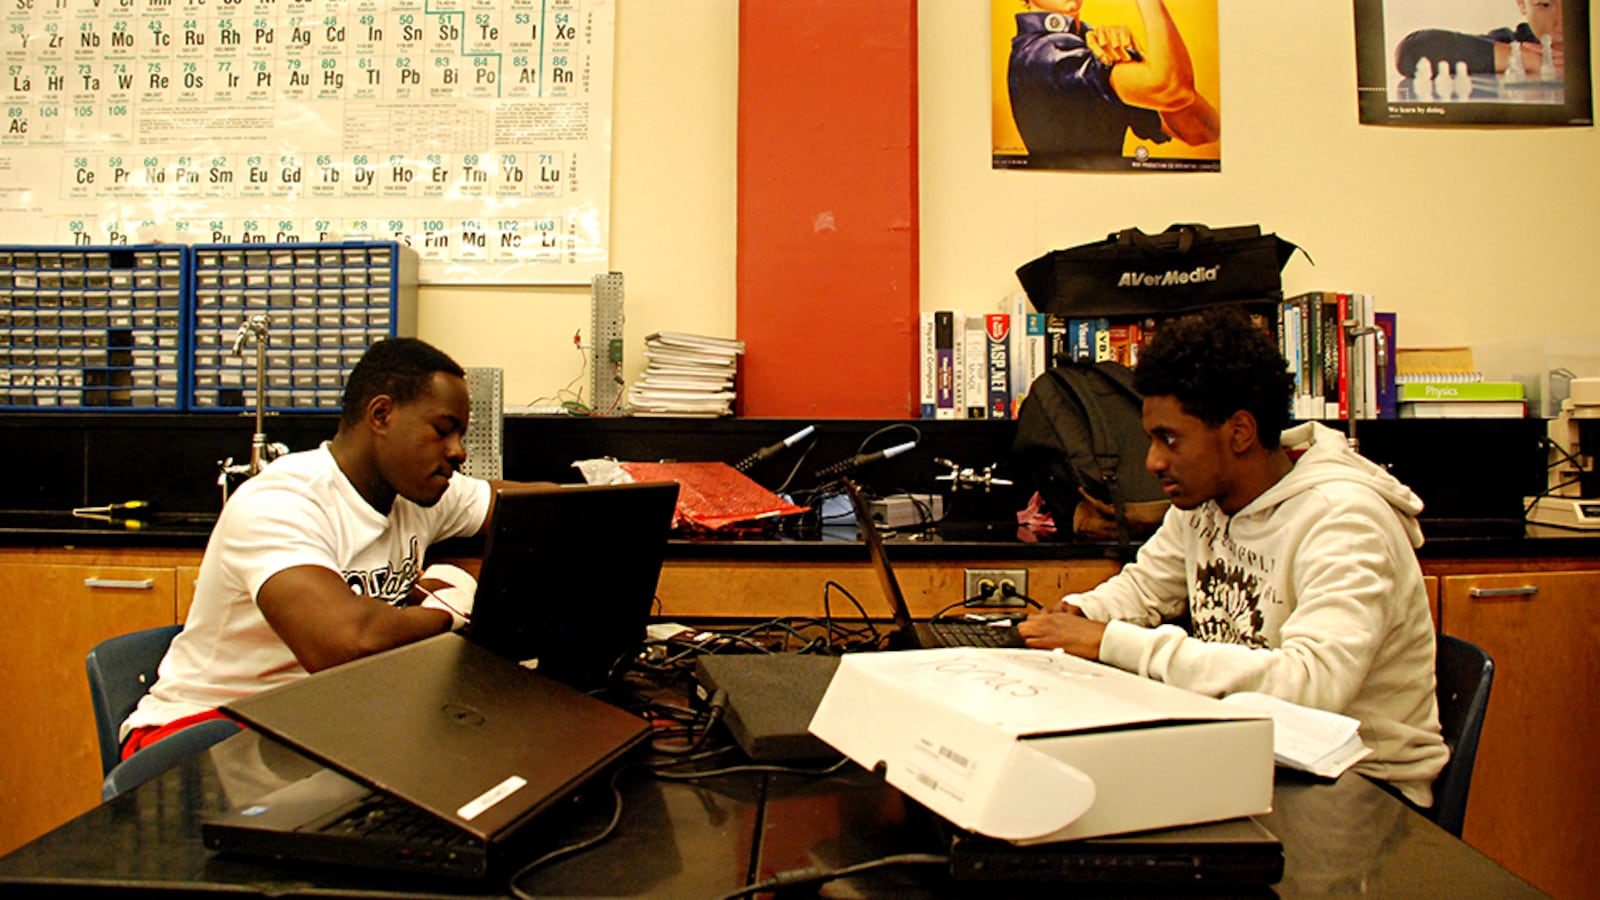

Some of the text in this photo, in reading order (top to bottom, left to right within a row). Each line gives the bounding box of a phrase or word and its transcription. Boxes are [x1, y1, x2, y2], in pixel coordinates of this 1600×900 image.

[253, 18, 266, 28] 46
[290, 18, 302, 27] 47
[323, 16, 337, 26] 48
[360, 15, 374, 24] 49
[400, 14, 413, 24] 50
[439, 15, 452, 24] 51
[476, 14, 490, 24] 52
[516, 14, 529, 23] 53
[555, 14, 569, 23] 54
[10, 24, 24, 33] 39
[44, 24, 57, 33] 40
[80, 22, 92, 32] 41
[114, 22, 126, 32] 42
[148, 21, 162, 31] 43
[184, 20, 196, 30] 44
[219, 19, 232, 29] 45
[221, 30, 240, 44] Rh
[256, 29, 273, 44] Pd
[292, 28, 310, 46] Ag
[326, 26, 344, 41] Cd
[369, 26, 382, 40] In
[404, 26, 422, 40] Sn
[440, 26, 458, 40] Sb
[480, 26, 498, 40] Te
[556, 25, 576, 40] Xe
[20, 34, 30, 48] Y
[49, 34, 64, 47] Zr
[81, 33, 100, 46] Nb
[112, 32, 133, 46] Mo
[154, 31, 170, 46] Tc
[186, 31, 204, 45] Ru
[218, 62, 231, 71] 77
[253, 62, 266, 71] 78
[288, 60, 300, 69] 79
[322, 58, 336, 68] 80
[359, 58, 372, 68] 81
[396, 58, 410, 68] 82
[436, 57, 449, 67] 83
[474, 57, 488, 66] 84
[513, 57, 528, 66] 85
[553, 57, 567, 66] 86
[9, 66, 22, 75] 57
[44, 66, 57, 75] 72
[79, 65, 91, 74] 73
[113, 65, 126, 74] 74
[148, 63, 160, 72] 75
[183, 63, 196, 72] 76
[150, 74, 168, 88] Re
[184, 74, 203, 88] Os
[229, 73, 239, 87] Ir
[257, 73, 271, 86] Pt
[290, 72, 309, 85] Au
[324, 70, 343, 88] Hg
[367, 70, 379, 84] Tl
[401, 69, 420, 84] Pb
[444, 69, 458, 84] Bi
[477, 69, 494, 84] Po
[520, 69, 536, 84] At
[553, 68, 572, 84] Rn
[48, 76, 64, 90] Hf
[83, 76, 99, 90] Ta
[119, 75, 132, 89] W
[8, 107, 22, 116] 89
[40, 107, 58, 116] 104
[74, 107, 92, 116] 105
[108, 106, 126, 115] 106
[74, 157, 87, 167] 58
[109, 157, 122, 167] 59
[144, 157, 157, 167] 60
[212, 157, 226, 166] 62
[247, 157, 261, 166] 63
[316, 156, 330, 164] 65
[353, 156, 368, 164] 66
[464, 155, 478, 164] 69
[502, 155, 516, 164] 70
[539, 155, 552, 164] 71
[76, 168, 94, 184] Ce
[115, 168, 129, 183] Pr
[210, 168, 232, 182] Sm
[250, 168, 267, 182] Eu
[282, 168, 301, 182] Gd
[322, 167, 339, 182] Tb
[355, 167, 374, 186] Dy
[393, 168, 413, 182] Ho
[432, 168, 448, 182] Er
[463, 167, 487, 182] Tm
[503, 167, 522, 182] Yb
[541, 167, 559, 182] Lu
[70, 222, 84, 231] 90
[210, 221, 223, 231] 94
[244, 221, 257, 230] 95
[280, 221, 293, 230] 96
[316, 221, 330, 230] 97
[389, 221, 403, 230] 99
[422, 221, 443, 231] 100
[73, 232, 90, 245] Th
[111, 232, 126, 245] Pa
[243, 232, 265, 243] Am
[277, 232, 299, 243] Cm
[462, 232, 486, 247] Md
[1118, 266, 1218, 286] AVerMedia
[926, 322, 934, 399] Physical Computing
[992, 344, 1006, 392] ASP.NET
[1425, 386, 1458, 397] Physics
